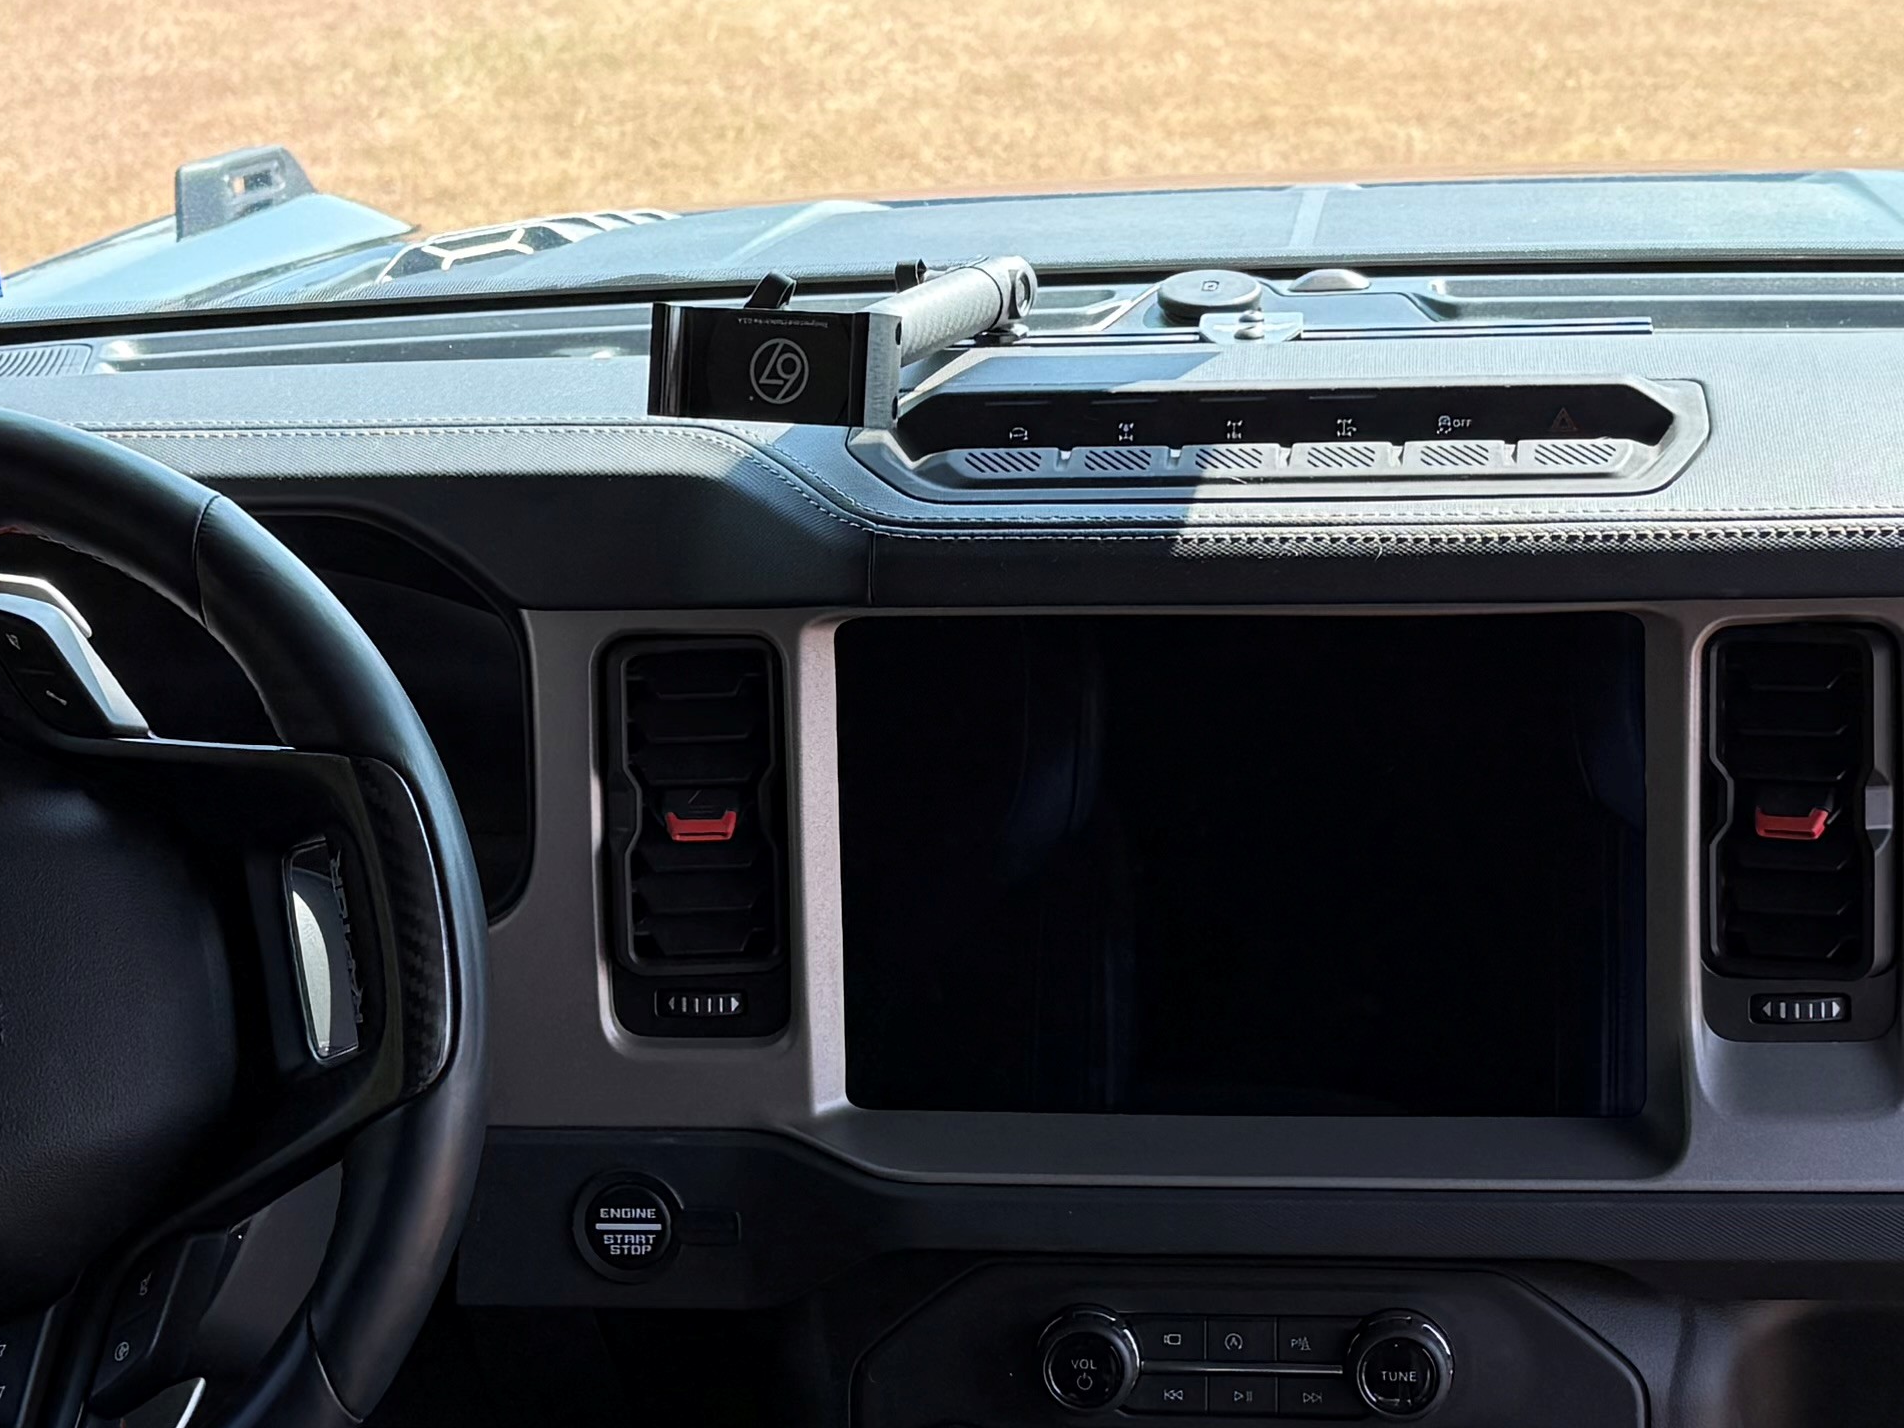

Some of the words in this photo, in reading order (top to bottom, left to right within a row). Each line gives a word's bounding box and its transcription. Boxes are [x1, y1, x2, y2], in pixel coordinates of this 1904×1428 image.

[600, 1208, 656, 1218] ENGINE
[603, 1234, 656, 1244] START
[610, 1245, 652, 1255] STOP
[1070, 1358, 1098, 1370] VOL
[1380, 1371, 1418, 1383] TUNE
